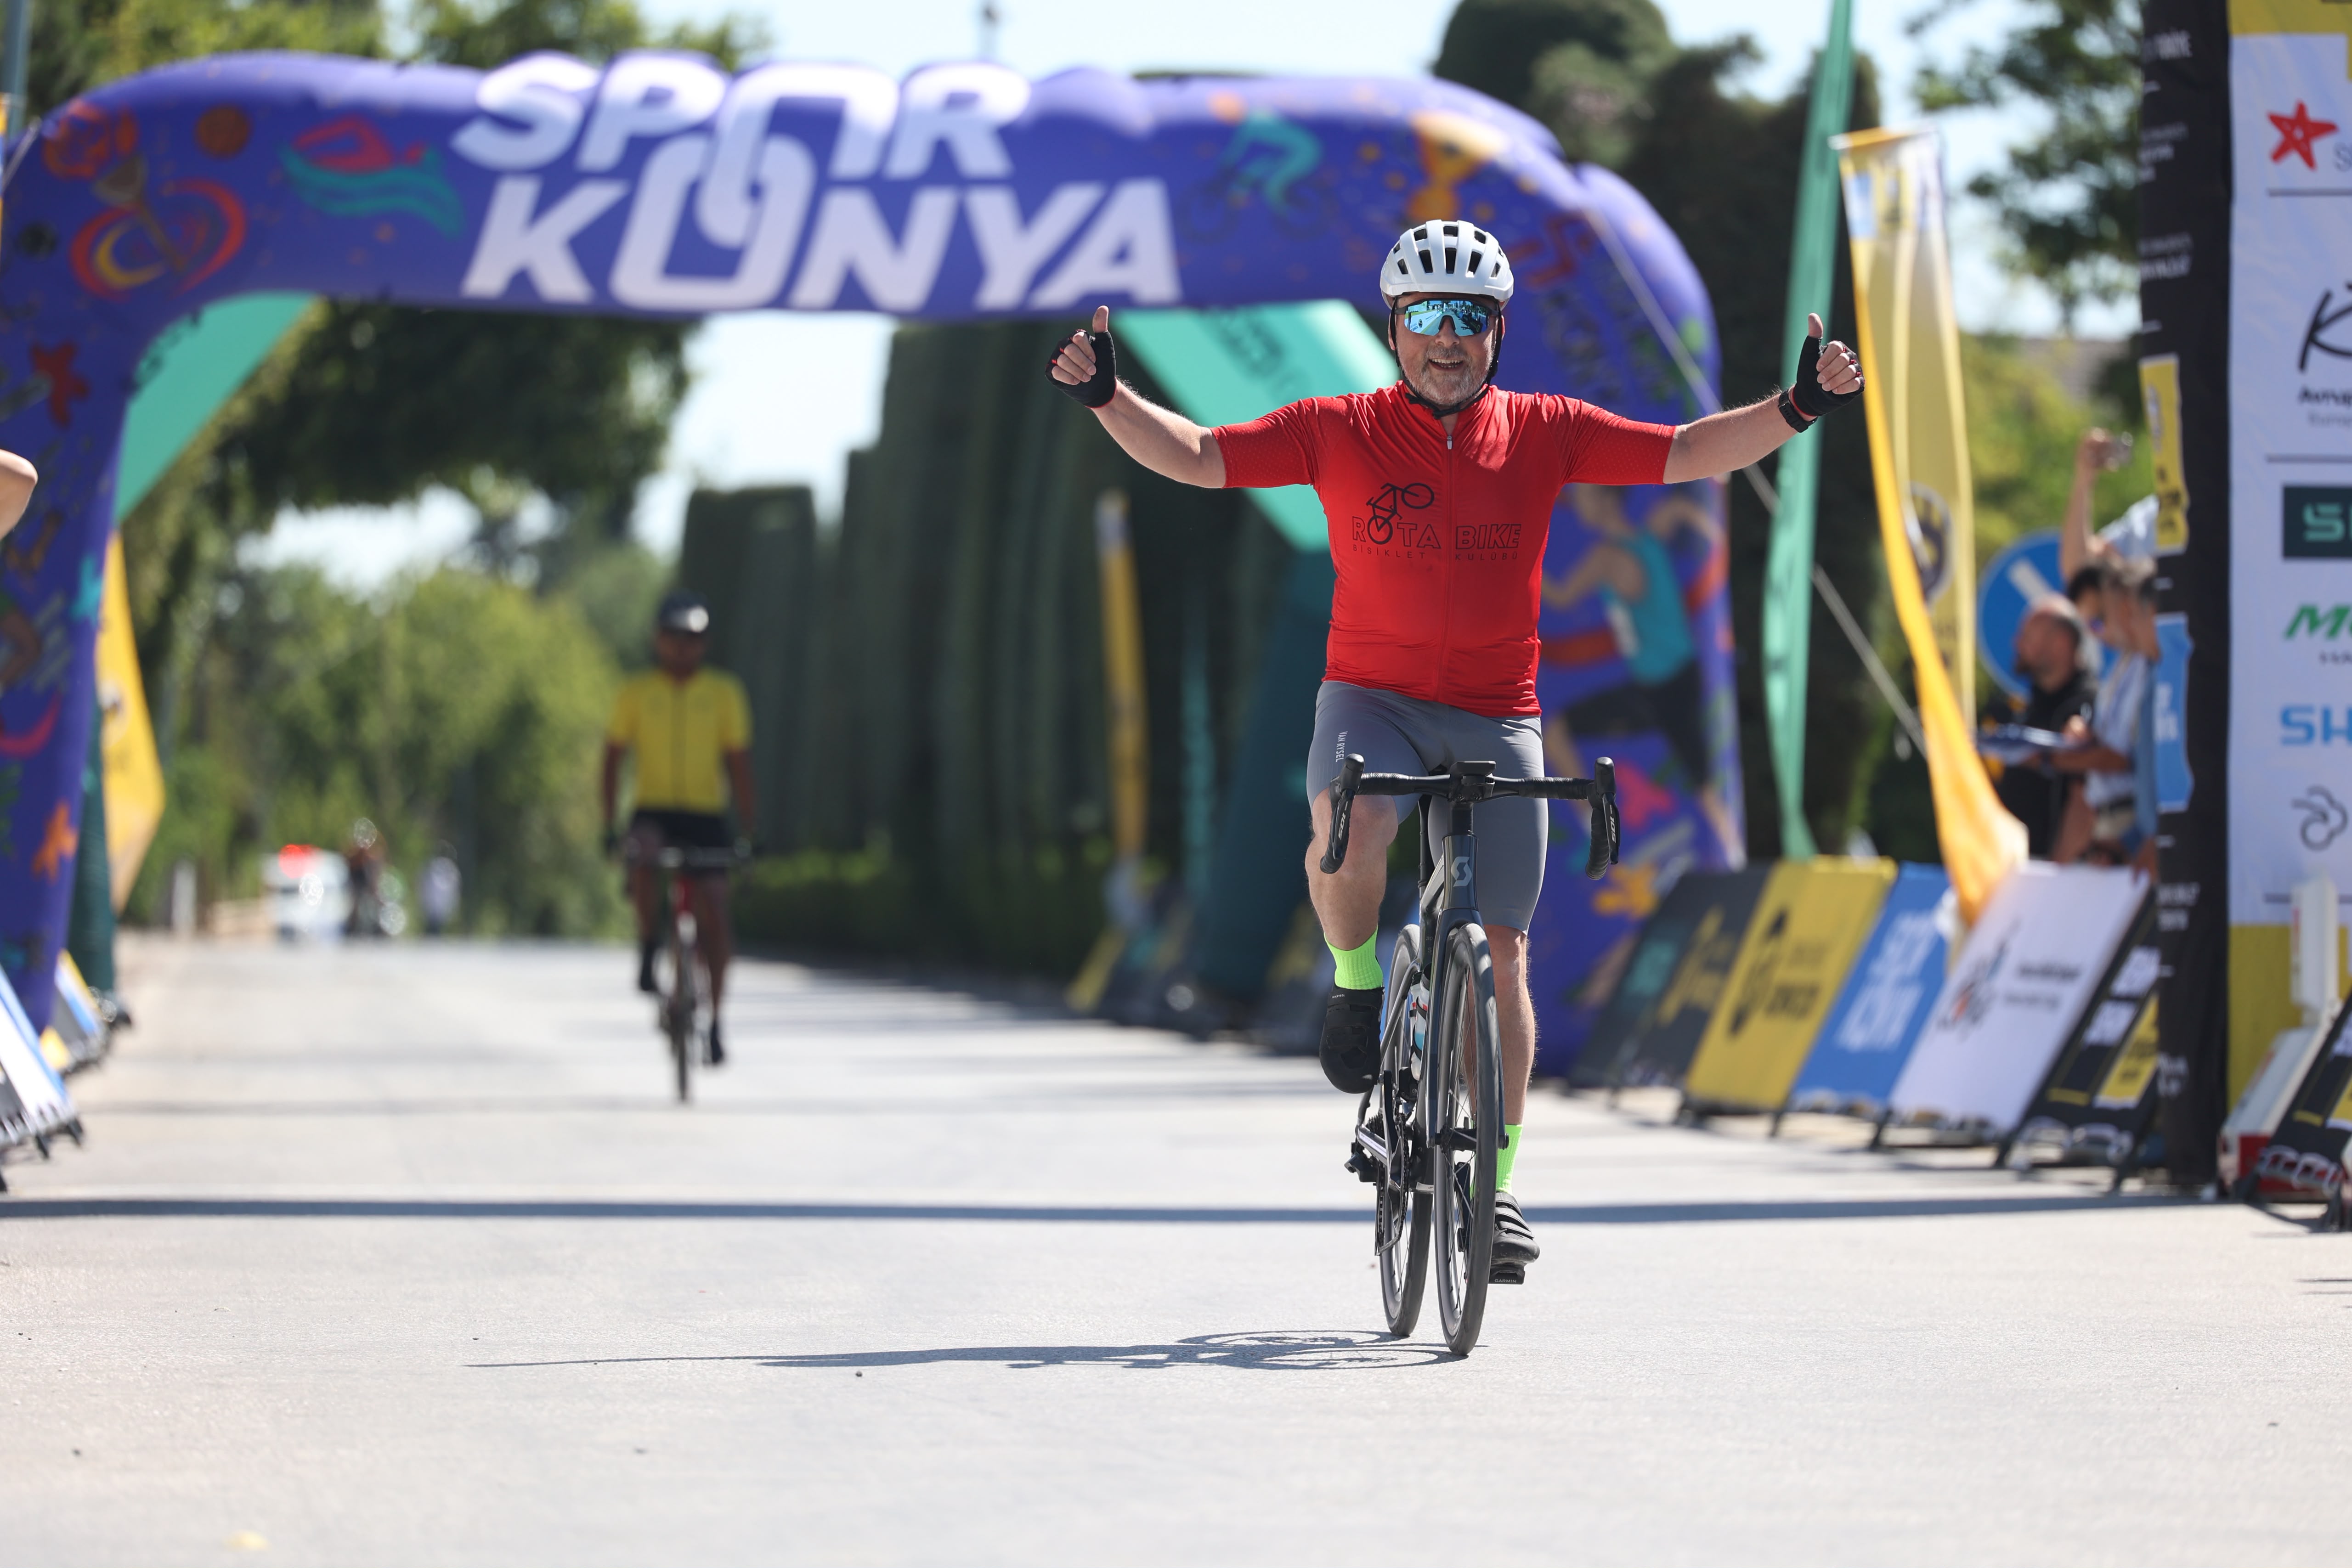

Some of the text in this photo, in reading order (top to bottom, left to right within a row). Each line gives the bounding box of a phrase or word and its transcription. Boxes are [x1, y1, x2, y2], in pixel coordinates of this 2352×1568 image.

[451, 51, 1031, 248] SPOR
[461, 135, 1182, 311] KONYA
[1456, 524, 1521, 550] BIKE
[1335, 731, 1348, 762] VAN RYSEL
